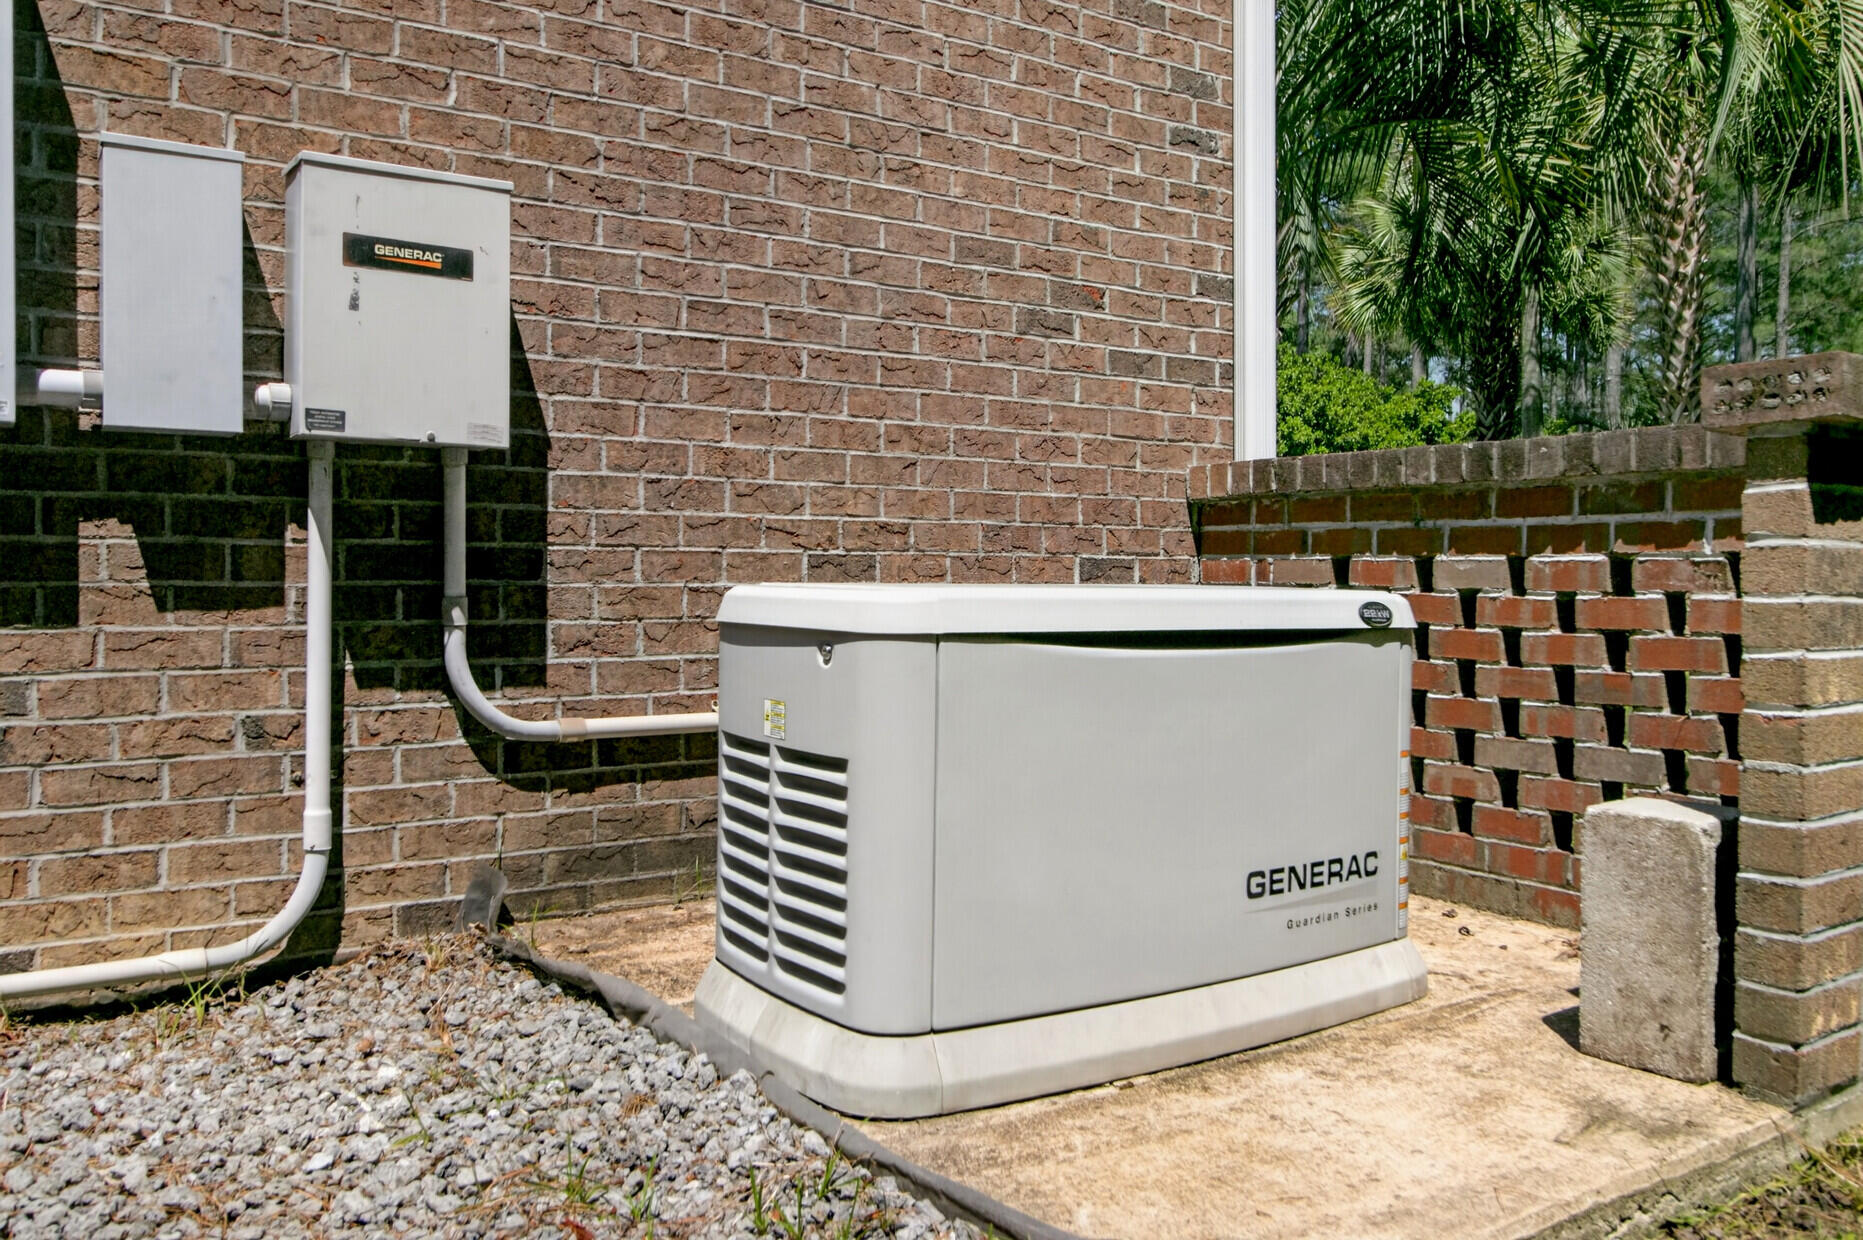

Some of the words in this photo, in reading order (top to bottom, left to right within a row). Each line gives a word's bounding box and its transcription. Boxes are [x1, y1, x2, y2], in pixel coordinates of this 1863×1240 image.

[374, 243, 443, 263] GENERAC
[1247, 851, 1379, 899] GENERAC
[1287, 911, 1339, 929] Guardian
[1345, 902, 1378, 918] Series
